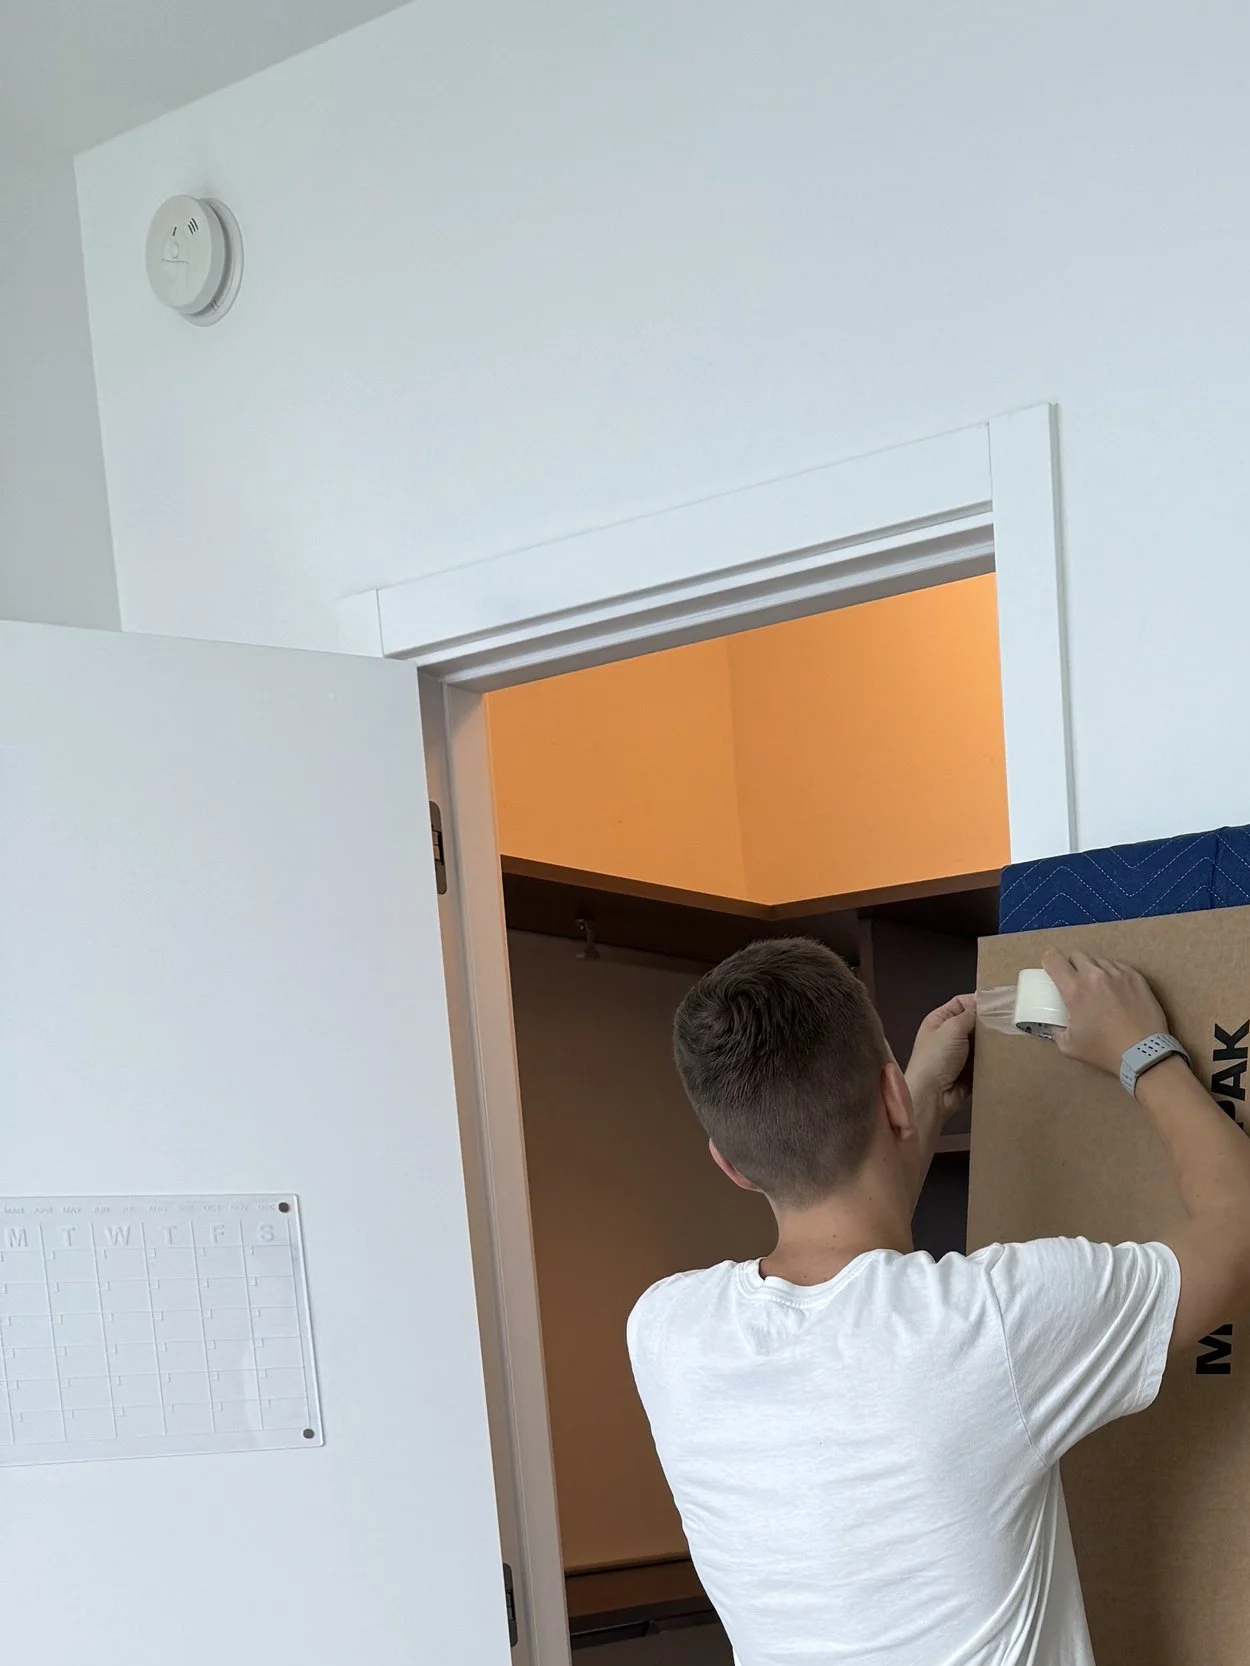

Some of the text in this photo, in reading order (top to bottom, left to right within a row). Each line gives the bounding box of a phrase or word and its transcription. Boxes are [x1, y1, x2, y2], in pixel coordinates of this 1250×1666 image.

[5, 1227, 28, 1247] M
[60, 1225, 76, 1247] T
[105, 1226, 131, 1246] W
[160, 1225, 177, 1245] T
[259, 1224, 275, 1241] S
